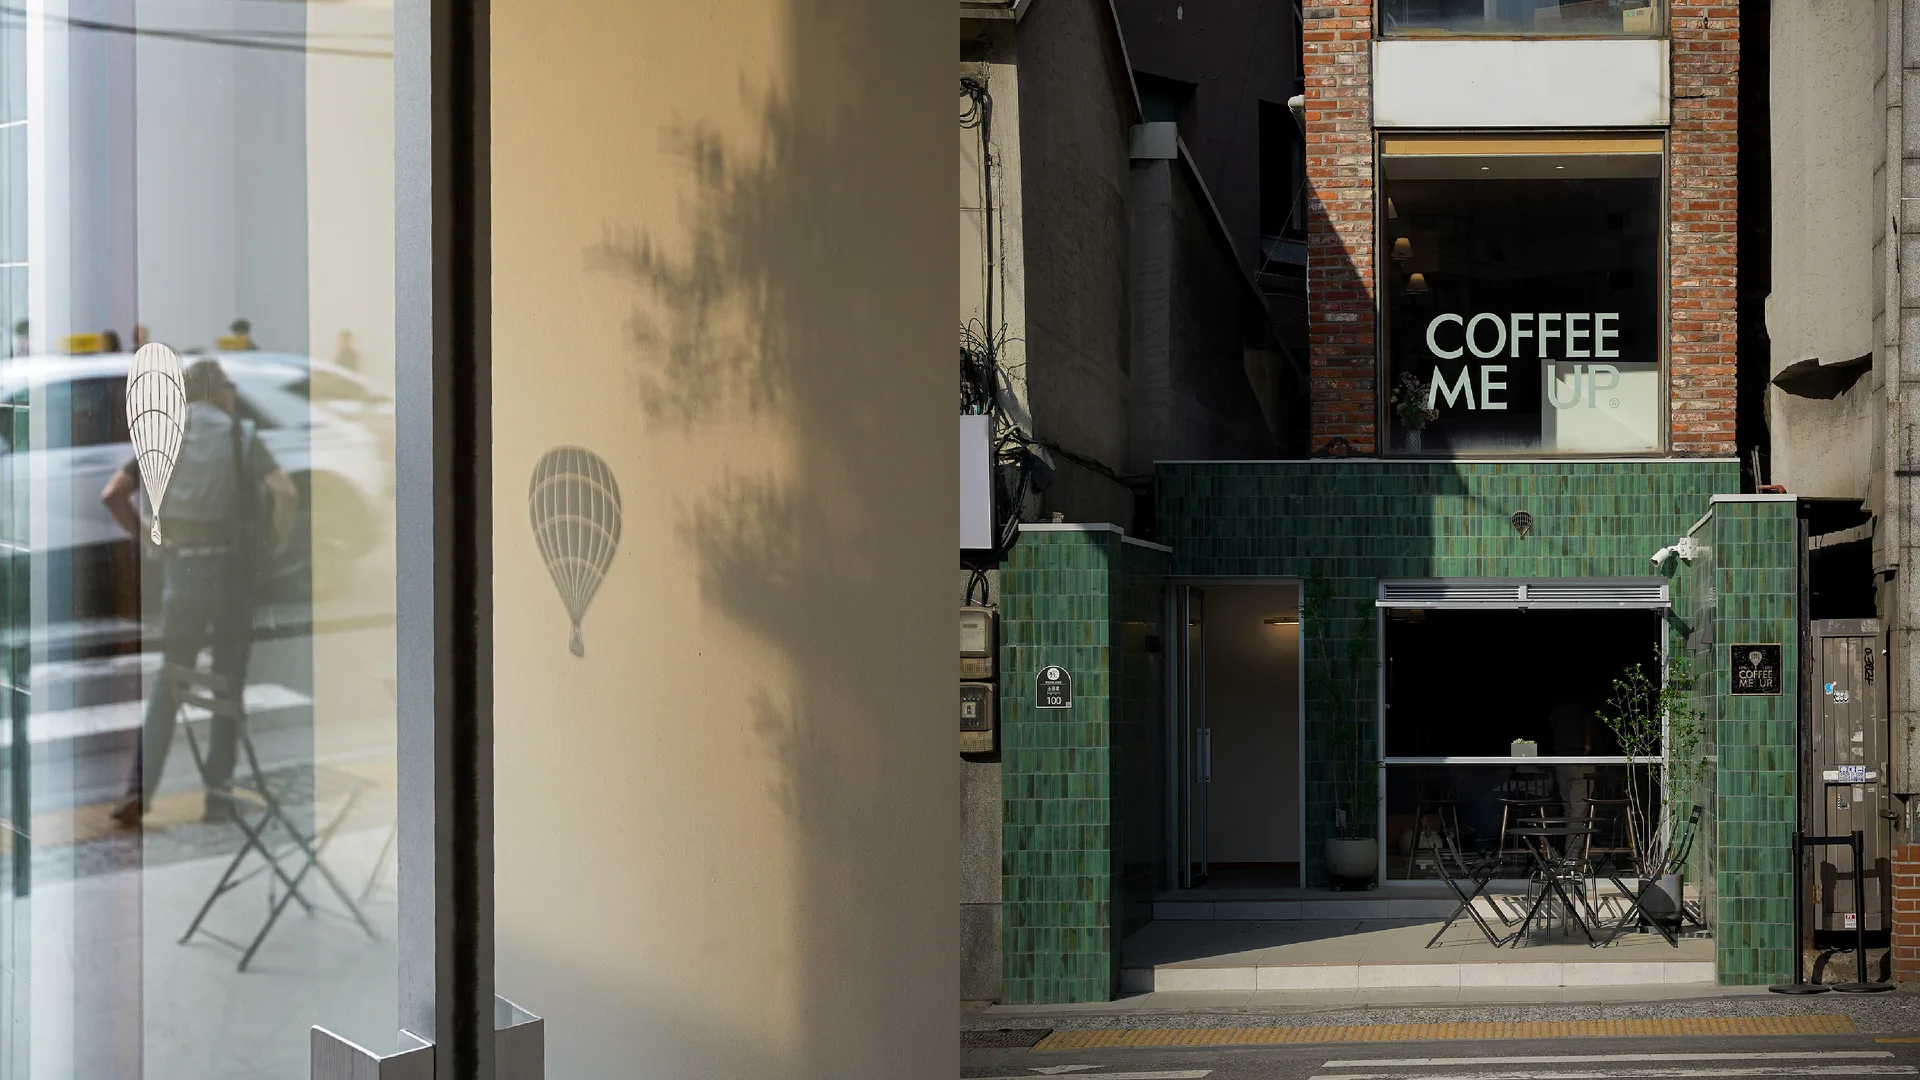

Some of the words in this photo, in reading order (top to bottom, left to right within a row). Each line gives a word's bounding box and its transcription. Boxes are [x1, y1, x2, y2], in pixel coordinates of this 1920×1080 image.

[1426, 312, 1620, 360] COFFEE
[1427, 364, 1508, 410] ME
[1739, 670, 1773, 679] COFFEE
[1739, 679, 1754, 688] ME
[1047, 696, 1061, 705] 100
